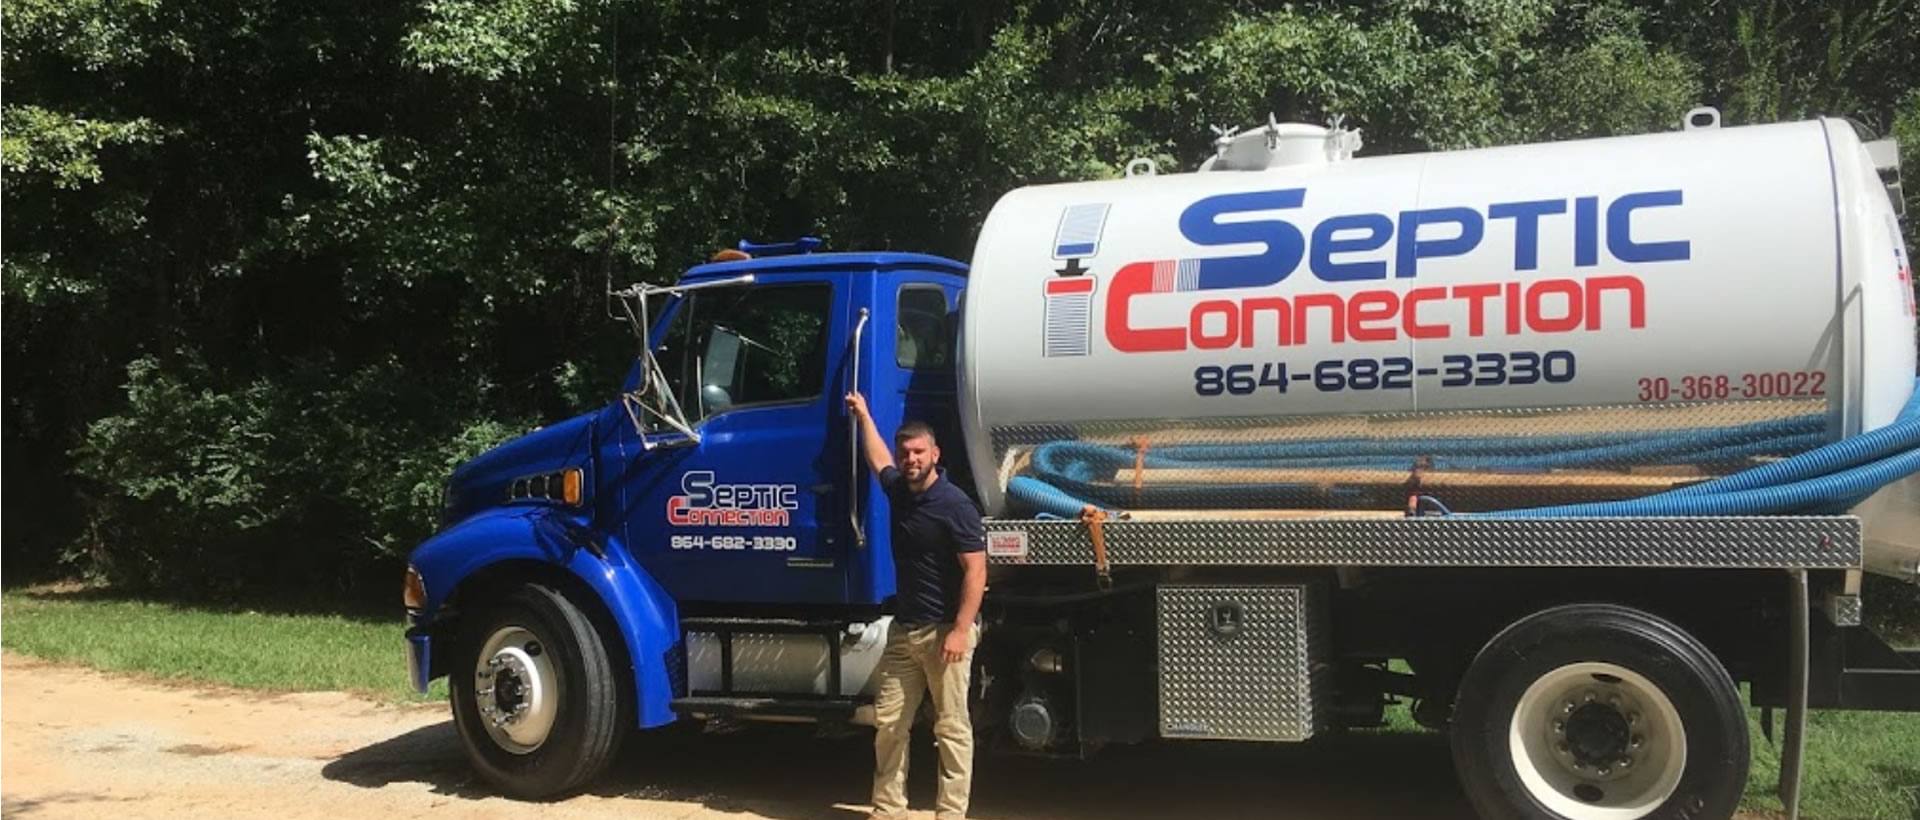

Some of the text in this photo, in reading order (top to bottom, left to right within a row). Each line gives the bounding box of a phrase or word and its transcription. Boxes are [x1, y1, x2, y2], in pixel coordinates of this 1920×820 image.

[1194, 350, 1576, 396] 864-682-3330
[1638, 371, 1826, 401] 30-368-30022
[671, 536, 796, 550] 864-682-3330
